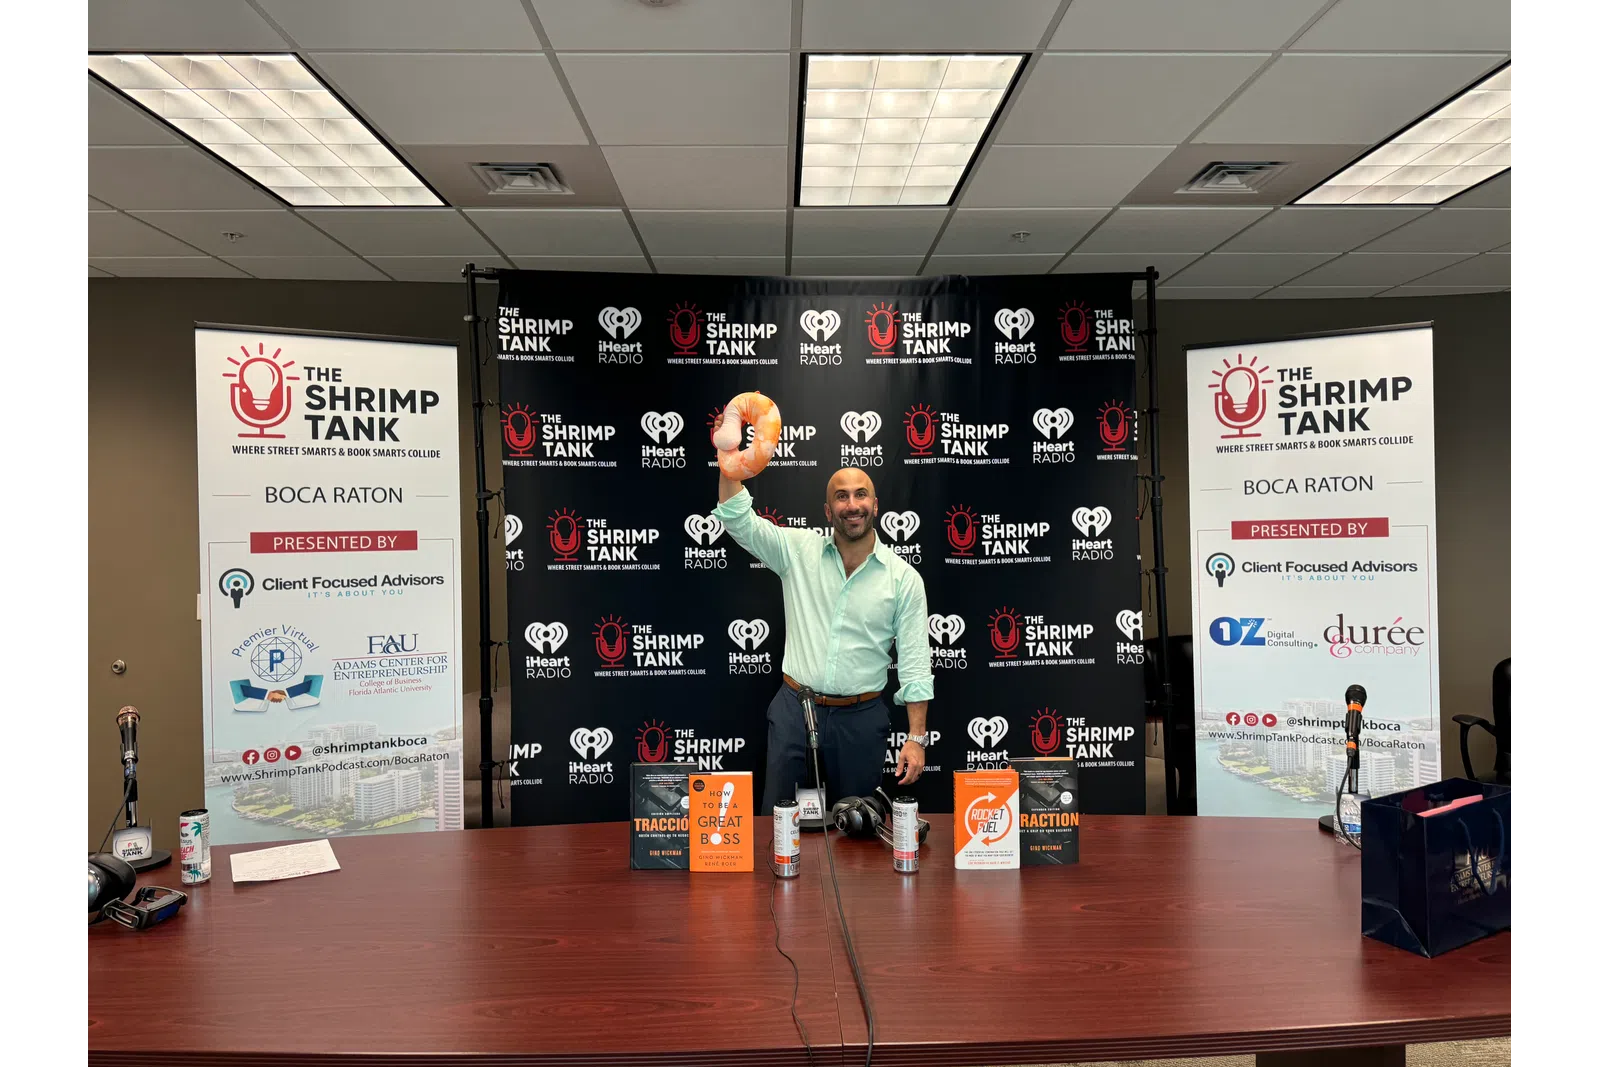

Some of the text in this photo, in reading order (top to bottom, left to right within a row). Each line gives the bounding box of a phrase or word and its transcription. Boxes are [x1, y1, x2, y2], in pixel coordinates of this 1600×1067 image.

[499, 306, 519, 317] THE
[706, 312, 726, 322] THE
[902, 313, 922, 322] THE
[499, 318, 573, 335] SHRIMP
[707, 323, 778, 339] SHRIMP
[902, 321, 971, 338] SHRIMP
[499, 335, 551, 352] TANK
[598, 340, 642, 353] iHeart
[707, 340, 756, 356] TANK
[800, 343, 842, 355] iHeart
[903, 338, 951, 355] TANK
[995, 342, 1036, 353] iHeart
[598, 353, 643, 364] RADIO
[801, 354, 842, 366] RADIO
[995, 353, 1037, 364] RADIO
[304, 366, 342, 382] THE
[1277, 367, 1313, 382] THE
[305, 384, 440, 414] SHRIMP
[1278, 376, 1412, 409] SHRIMP
[541, 414, 561, 424] THE
[940, 413, 960, 423] THE
[1278, 407, 1370, 435] TANK
[304, 415, 400, 442] TANK
[542, 425, 616, 441] SHRIMP
[941, 423, 1009, 439] SHRIMP
[542, 442, 594, 458] TANK
[641, 445, 685, 457] iHeart
[840, 444, 882, 456] iHeart
[941, 440, 988, 456] TANK
[1033, 441, 1074, 452] iHeart
[1216, 436, 1413, 453] WHERE STREET SMARTS & BOOK SMARTS COLLIDE
[232, 445, 441, 458] WHERE STREET SMARTS & BOOK SMARTS COLLIDE
[1033, 452, 1075, 463] RADIO
[641, 457, 686, 468] RADIO
[841, 456, 883, 467] RADIO
[1244, 475, 1373, 495] BOCA RATON
[265, 486, 403, 504] BOCA RATON
[586, 519, 607, 528] THE
[981, 514, 1000, 524] THE
[982, 522, 1050, 539] SHRIMP
[1251, 522, 1368, 537] PRESENTED BY
[273, 536, 397, 550] PRESENTED BY
[588, 529, 659, 544] SHRIMP
[982, 540, 1030, 556] TANK
[1072, 538, 1112, 550] iHeart
[588, 546, 638, 561] TANK
[684, 547, 726, 558] iHeart
[1072, 550, 1114, 561] RADIO
[684, 559, 727, 569] RADIO
[1242, 560, 1418, 573] Client Focused Advisors
[262, 574, 444, 590] Client Focused Advisors
[1025, 615, 1044, 625] THE
[632, 625, 652, 634] THE
[1026, 624, 1094, 640] SHRIMP
[1267, 630, 1295, 640] Digital
[1323, 613, 1424, 646] durée
[232, 624, 320, 658] Premier Virtual
[633, 635, 704, 650] SHRIMP
[1026, 641, 1073, 656] TANK
[1354, 644, 1420, 657] company
[333, 655, 448, 670] ADAMS CENTER FOR
[526, 656, 570, 667] iHeart
[633, 651, 684, 667] TANK
[729, 652, 770, 663] iHeart
[334, 665, 448, 681] ENTREPRENEURSHIP
[526, 668, 571, 679] RADIO
[729, 663, 772, 674] RADIO
[360, 677, 422, 688] College of Business
[349, 683, 432, 696] Florida Atlantic University
[1066, 717, 1085, 727] THE
[1287, 716, 1401, 732] @shrimptkboca
[675, 729, 694, 738] THE
[1066, 726, 1134, 743] SHRIMP
[312, 736, 427, 756] @shrimptankboca
[674, 737, 746, 755] SHRIMP
[1066, 742, 1113, 758] TANK
[967, 750, 1008, 761] iHeart
[221, 752, 449, 783] www.ShrimpTankPodcast.com/BocaRaton
[569, 761, 612, 773] iHeart
[569, 773, 614, 784] RADIO
[971, 809, 1004, 820] ROCKET
[1020, 812, 1079, 827] RACTION
[634, 815, 689, 832] TRACCIÓ
[698, 816, 742, 827] GREAT
[977, 822, 998, 832] FUEL
